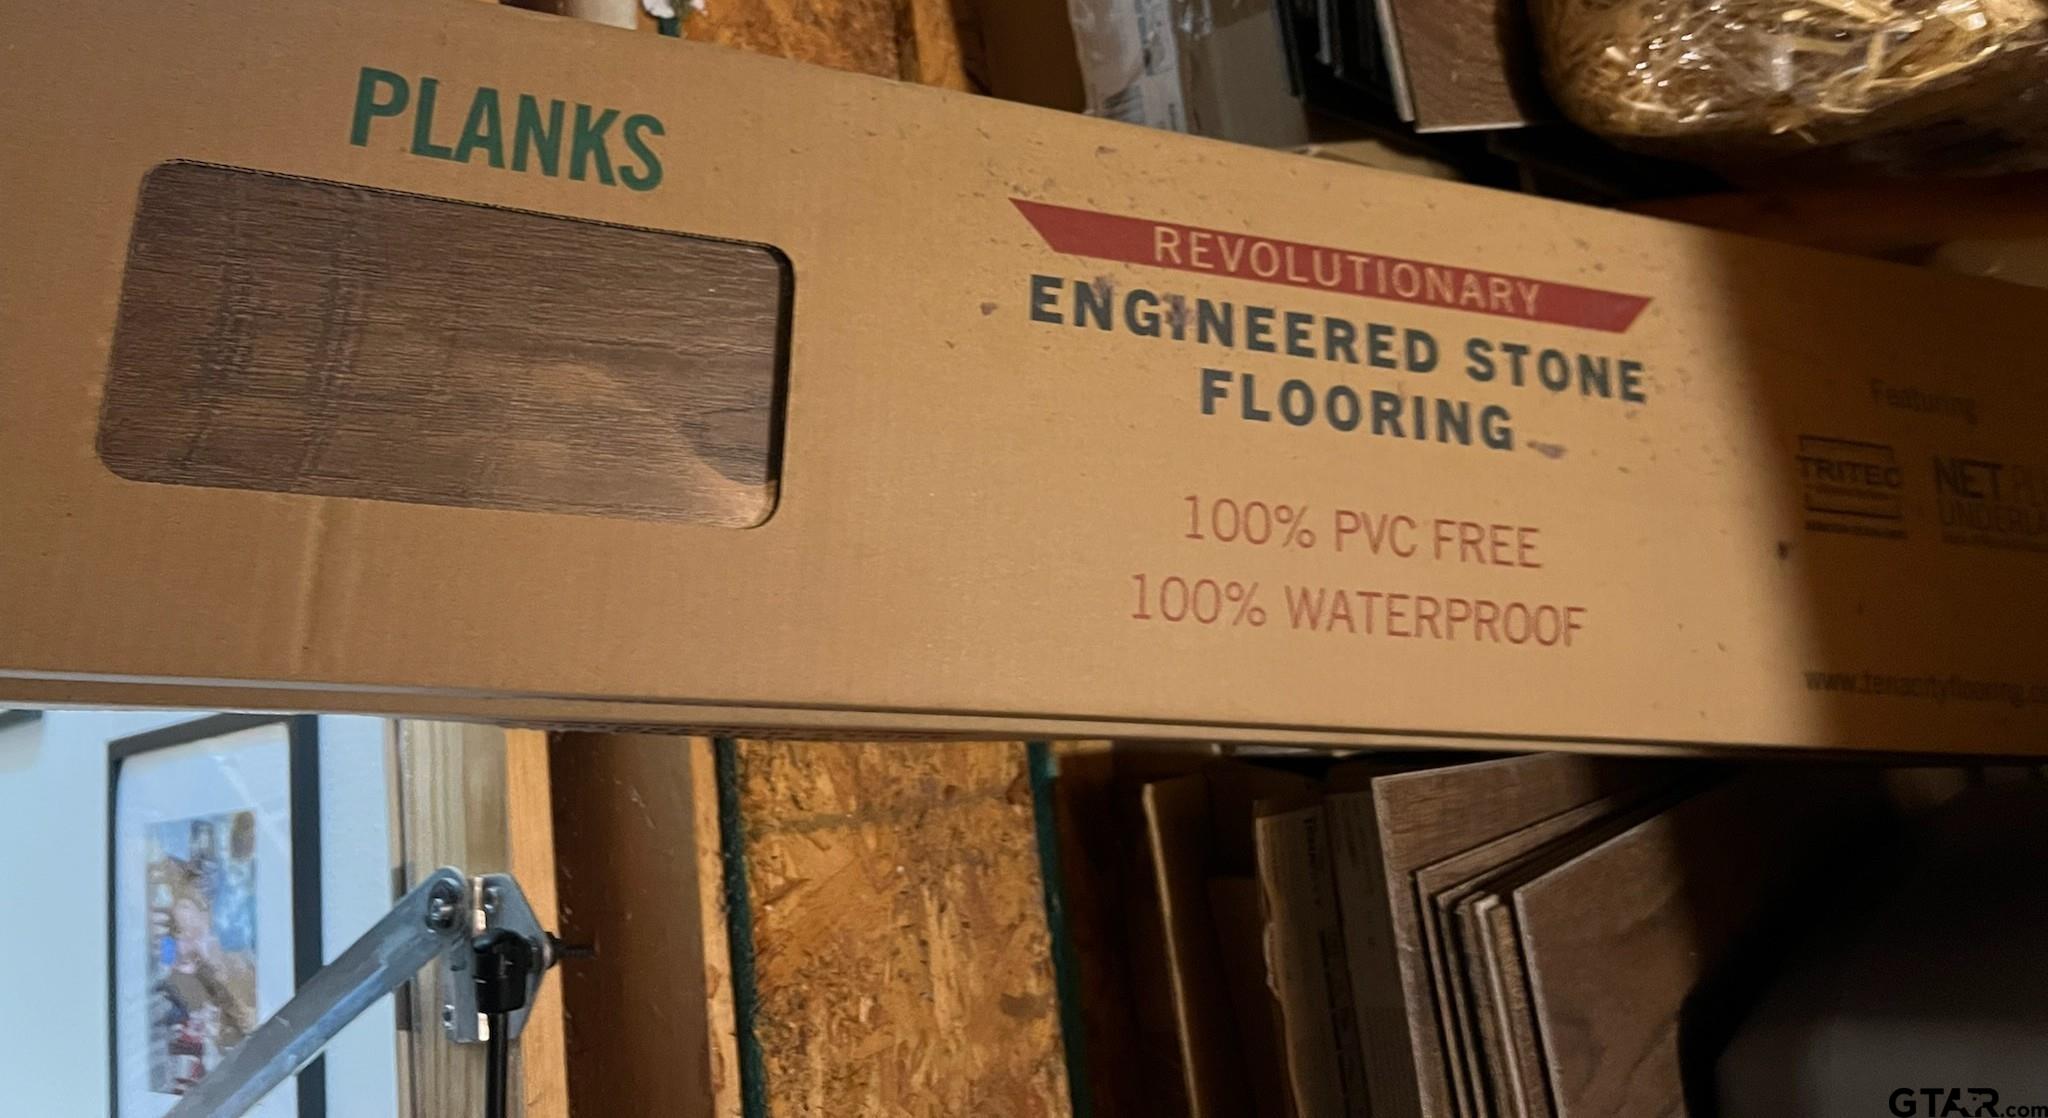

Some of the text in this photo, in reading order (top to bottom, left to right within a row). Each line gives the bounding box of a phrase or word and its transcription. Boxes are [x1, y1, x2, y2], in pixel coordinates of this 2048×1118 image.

[350, 66, 665, 192] PLANKS
[1154, 225, 1541, 317] REVOLUTIONARY
[1029, 274, 1646, 403] ENGINEERED STONE
[1201, 367, 1515, 451] FLOORING
[1796, 455, 1902, 488] TRITEC
[1183, 494, 1544, 569] 100% PVC FREE
[1131, 572, 1588, 647] 100% WATERPROOF
